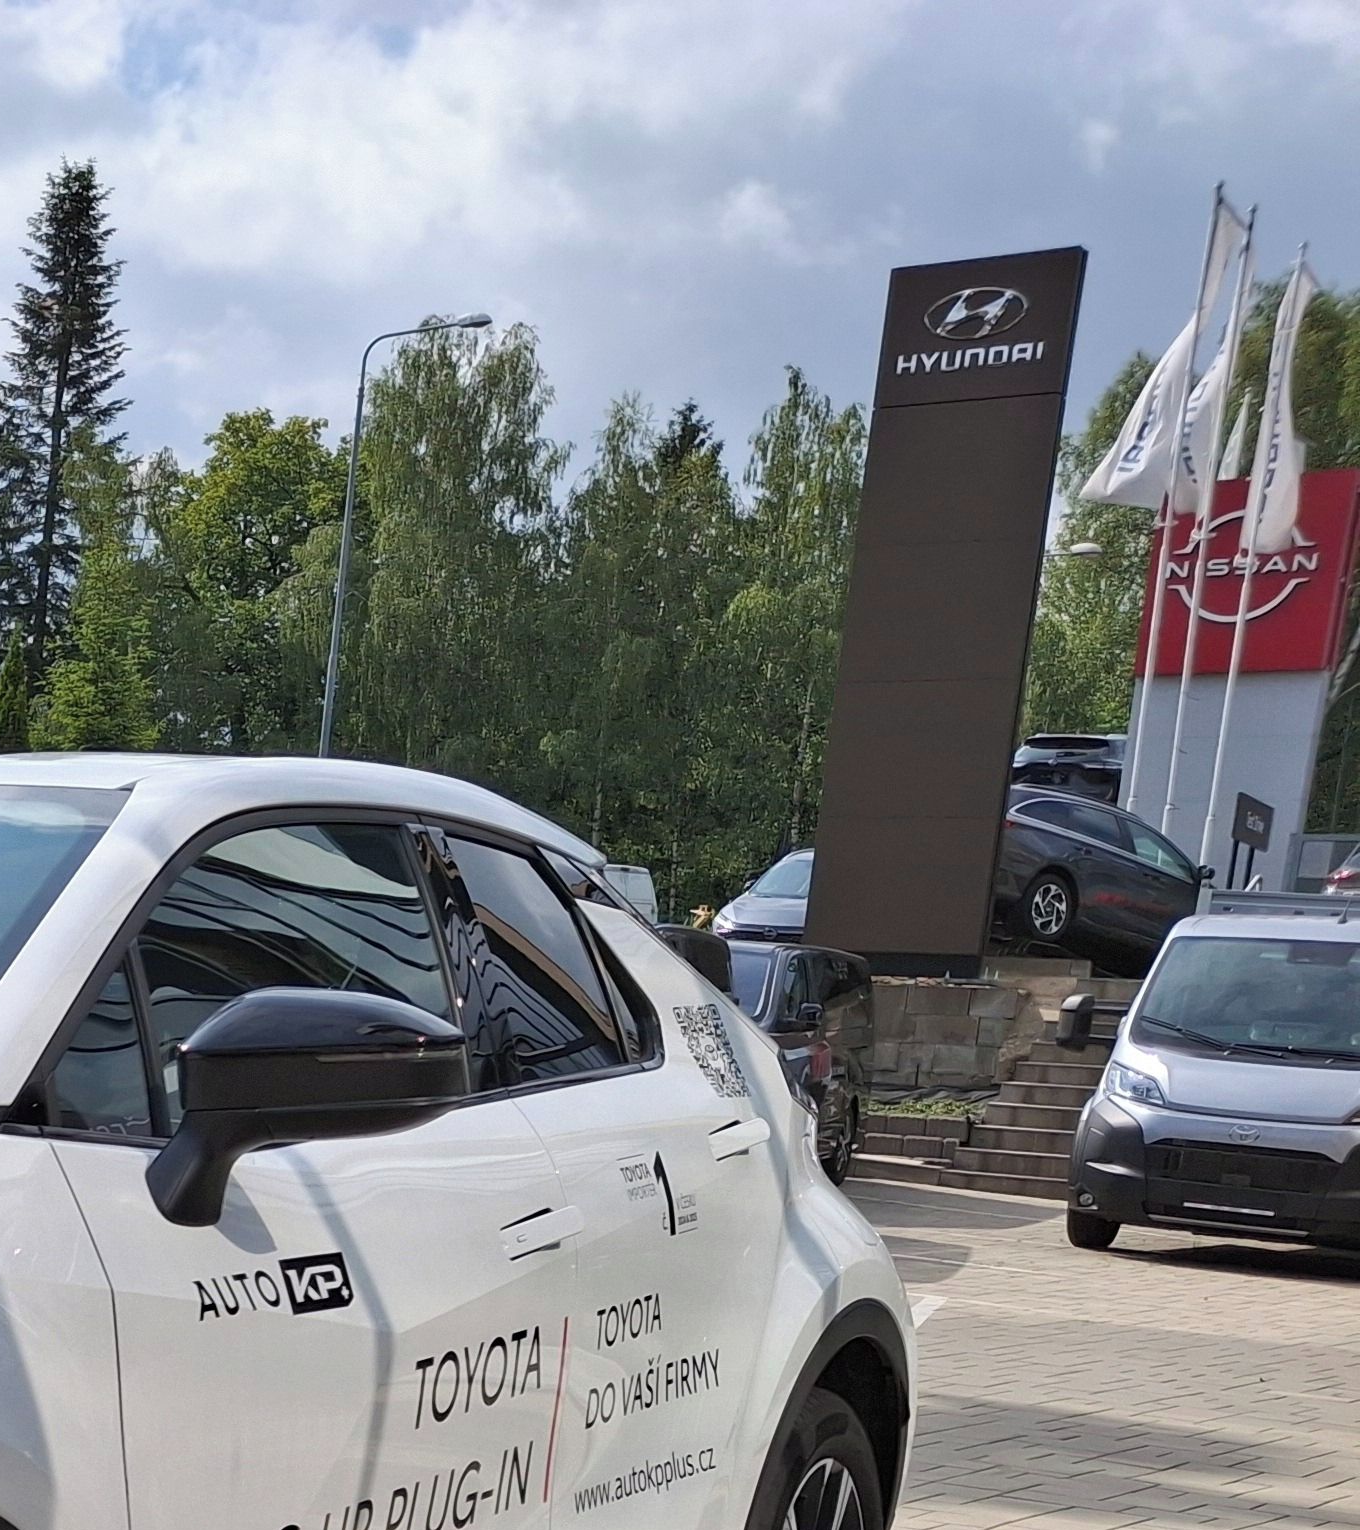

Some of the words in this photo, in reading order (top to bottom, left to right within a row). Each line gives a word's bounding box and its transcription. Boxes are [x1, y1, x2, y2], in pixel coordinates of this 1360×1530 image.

[895, 341, 1045, 375] HYUNDAI
[1165, 552, 1319, 580] NSSAN
[619, 1163, 653, 1184] TOYOTA
[192, 1270, 281, 1321] AUTO
[596, 1292, 662, 1350] TOYOTA
[414, 1325, 542, 1430] TOYOTA
[584, 1382, 617, 1430] DO
[621, 1354, 662, 1417] VAŠÍ
[665, 1348, 720, 1402] FIRMY
[574, 1447, 717, 1514] www.autokpplus.cz
